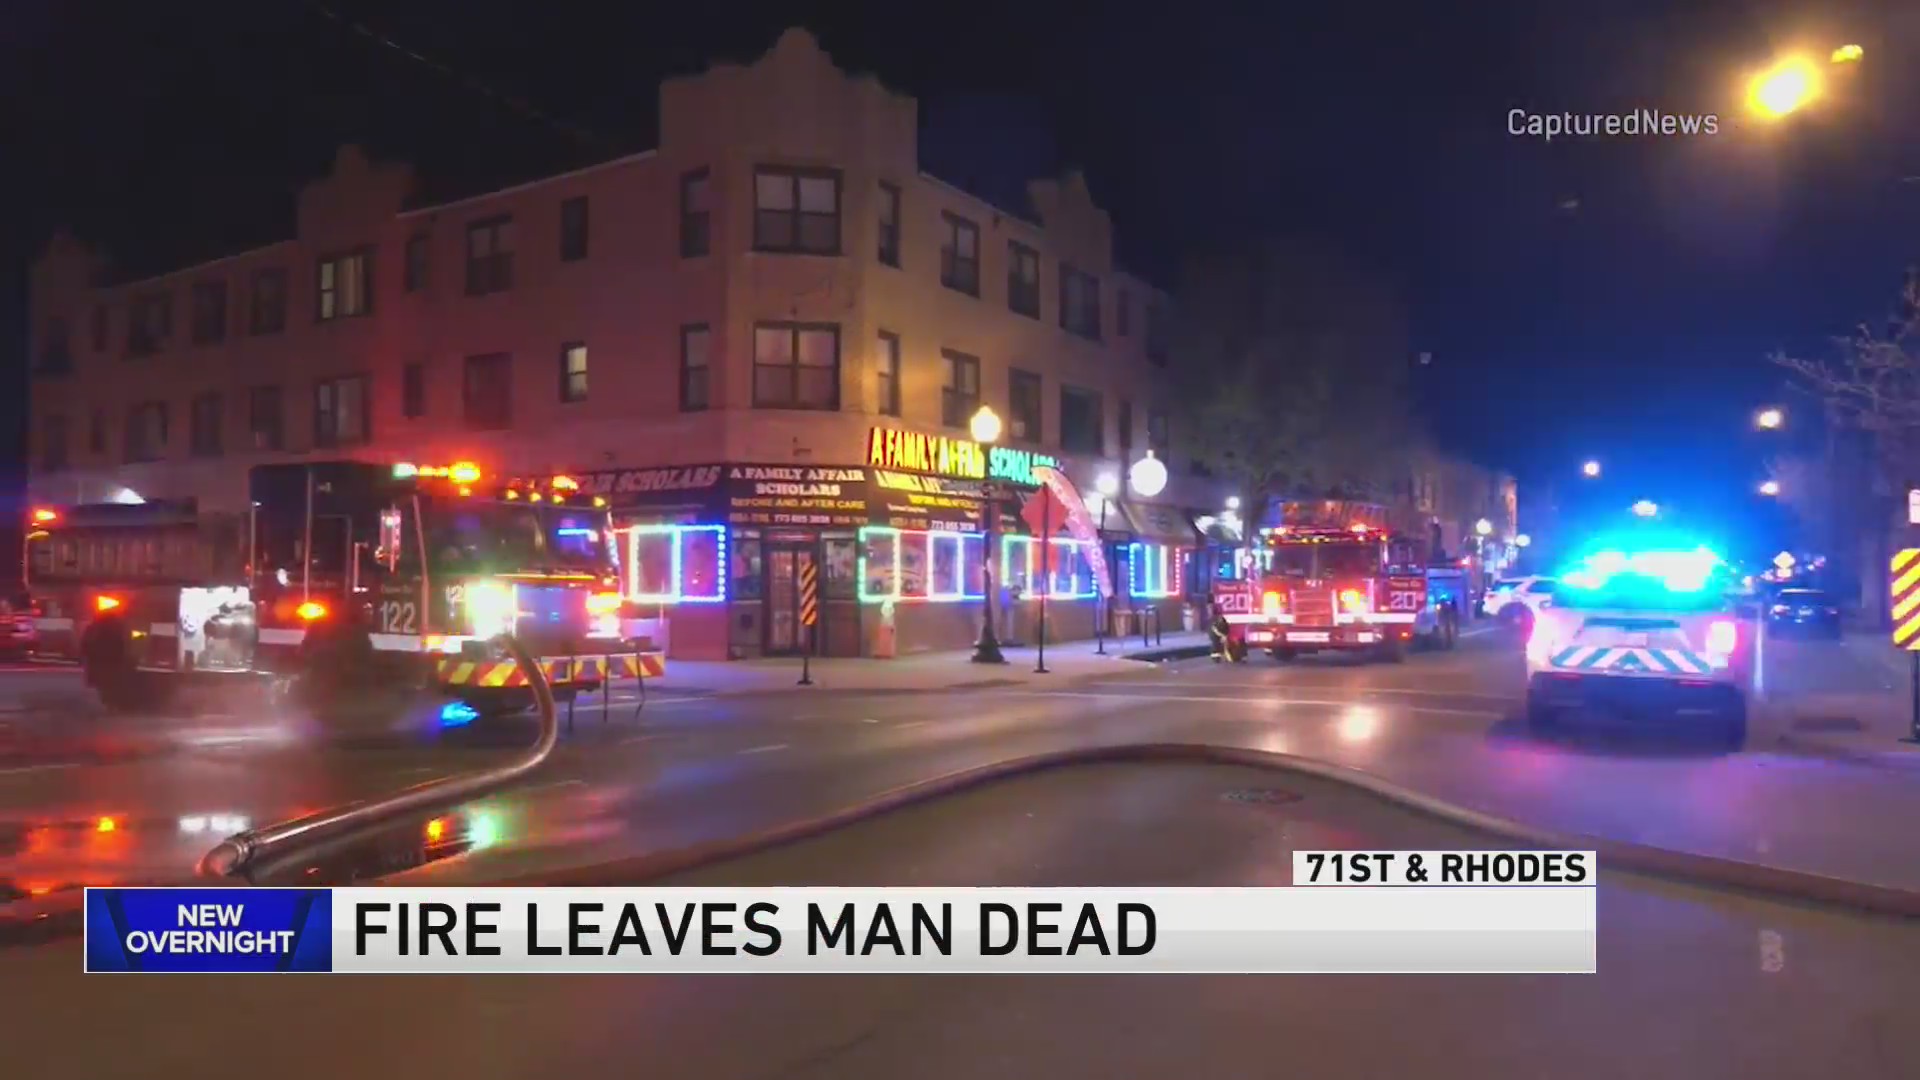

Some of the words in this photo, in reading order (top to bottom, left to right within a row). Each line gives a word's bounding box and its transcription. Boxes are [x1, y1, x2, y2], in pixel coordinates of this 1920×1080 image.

[870, 427, 884, 464] A
[885, 430, 937, 472] FAMILY
[730, 467, 742, 479] A
[745, 467, 802, 480] FAMILY
[807, 469, 865, 481] AFFAIR
[755, 483, 841, 496] SCHOLARS
[1390, 591, 1417, 610] 20
[380, 601, 417, 633] 122
